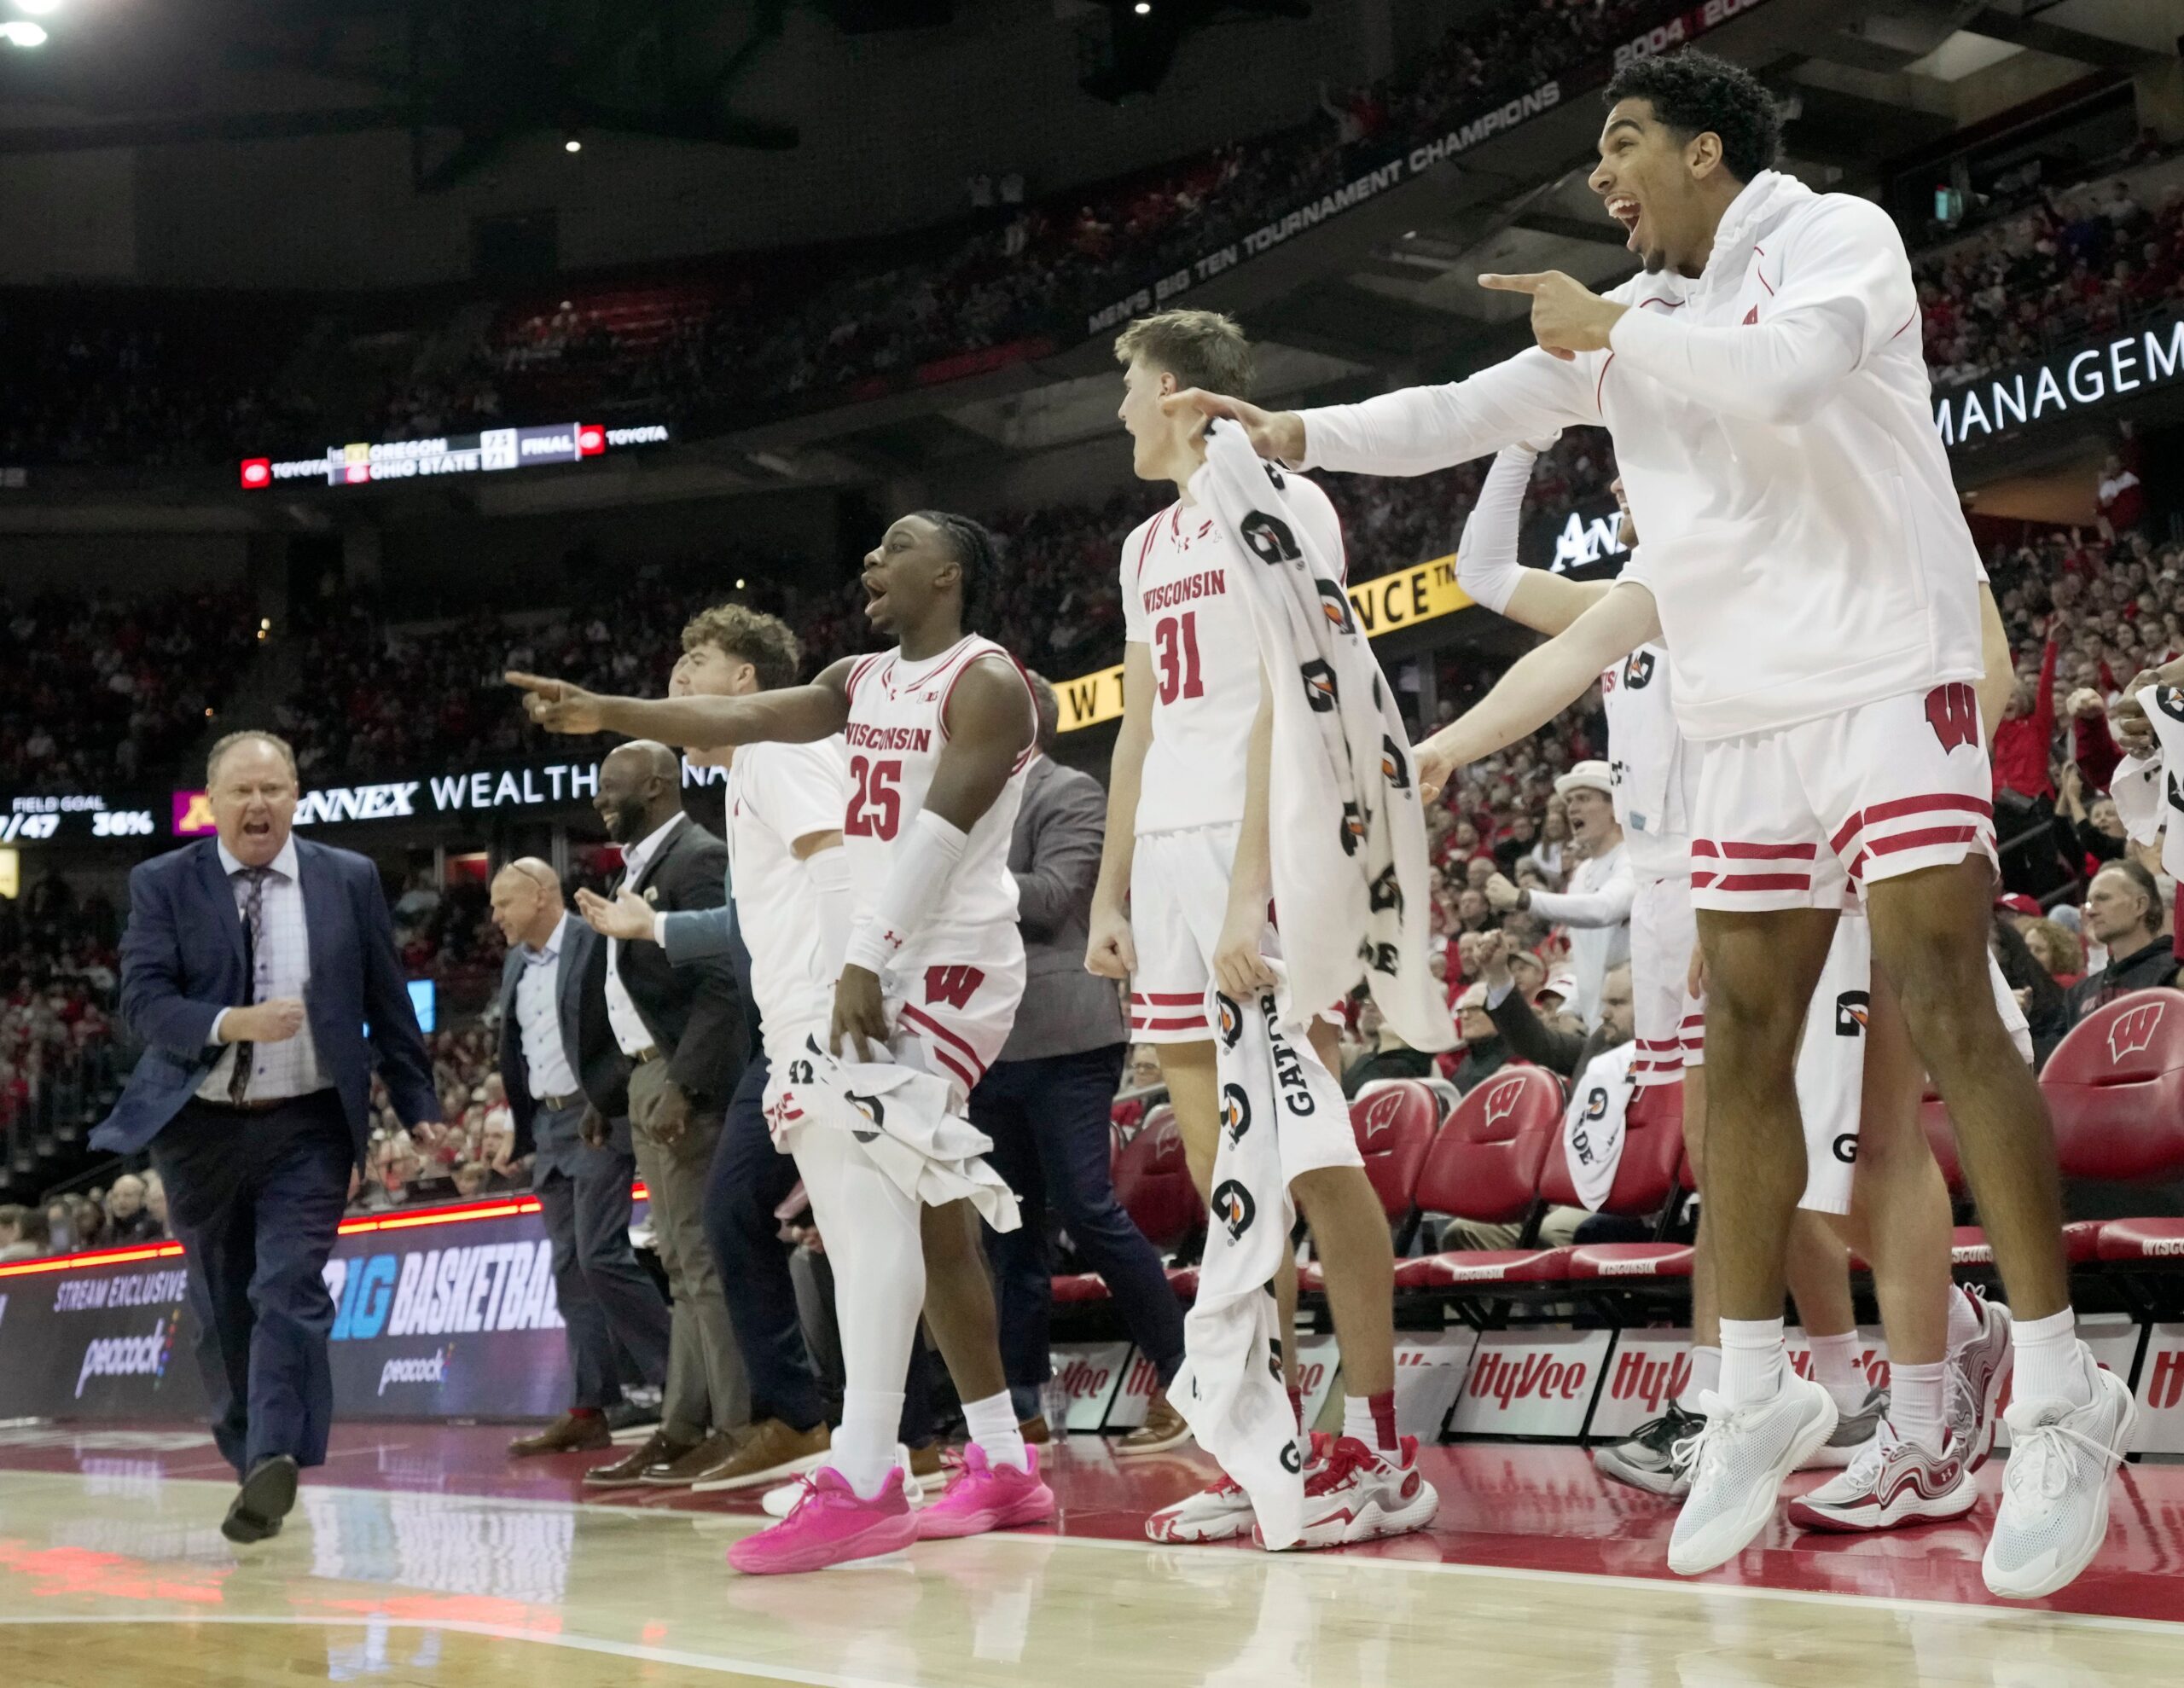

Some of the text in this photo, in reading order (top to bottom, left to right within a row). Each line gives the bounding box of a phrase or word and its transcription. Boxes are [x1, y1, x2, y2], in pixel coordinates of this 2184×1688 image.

[1154, 268, 1191, 303] BIG
[1195, 244, 1238, 282] TEN
[1243, 160, 1404, 254] TOURNAMENT
[1408, 81, 1561, 171] CHAMPIONS
[369, 438, 449, 461] OREGON
[521, 434, 574, 457] FINAL
[607, 425, 669, 446] TOYOTA
[270, 457, 330, 479] TOYOTA
[369, 458, 418, 480] OHIO
[417, 453, 479, 476] STATE
[1143, 569, 1227, 616] WISCONSIN
[1155, 611, 1205, 706] 31
[12, 795, 107, 813] FIELD GOAL
[429, 764, 597, 811] WEALTH
[844, 755, 902, 842] 25
[92, 810, 155, 837] 36%
[53, 1279, 111, 1314] STREAM
[107, 1269, 189, 1308] EXCLUSIVE
[386, 1238, 566, 1337] BASKETBAL
[75, 1318, 166, 1399] peacock
[377, 1347, 445, 1397] peacock
[1469, 1351, 1588, 1411] HyVee
